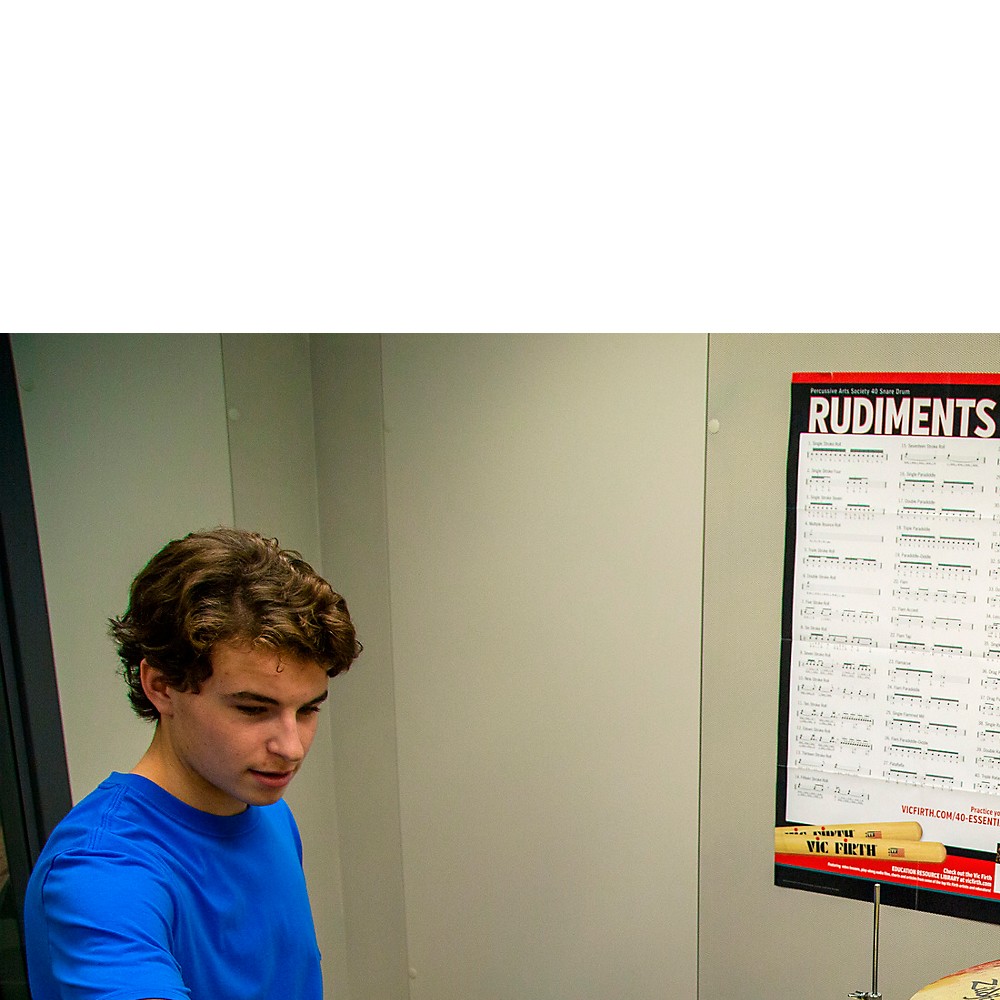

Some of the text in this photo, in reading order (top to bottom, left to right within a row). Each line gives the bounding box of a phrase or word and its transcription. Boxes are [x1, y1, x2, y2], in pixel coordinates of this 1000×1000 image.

[850, 387, 869, 395] Society
[808, 396, 997, 438] RUDIMENTS
[970, 806, 992, 814] Practice
[806, 837, 878, 856] VIC FIRTH
[891, 866, 916, 874] EDUCATION
[916, 869, 939, 878] RESOURCE
[940, 873, 959, 881] LIBRARY
[943, 867, 956, 875] Check
